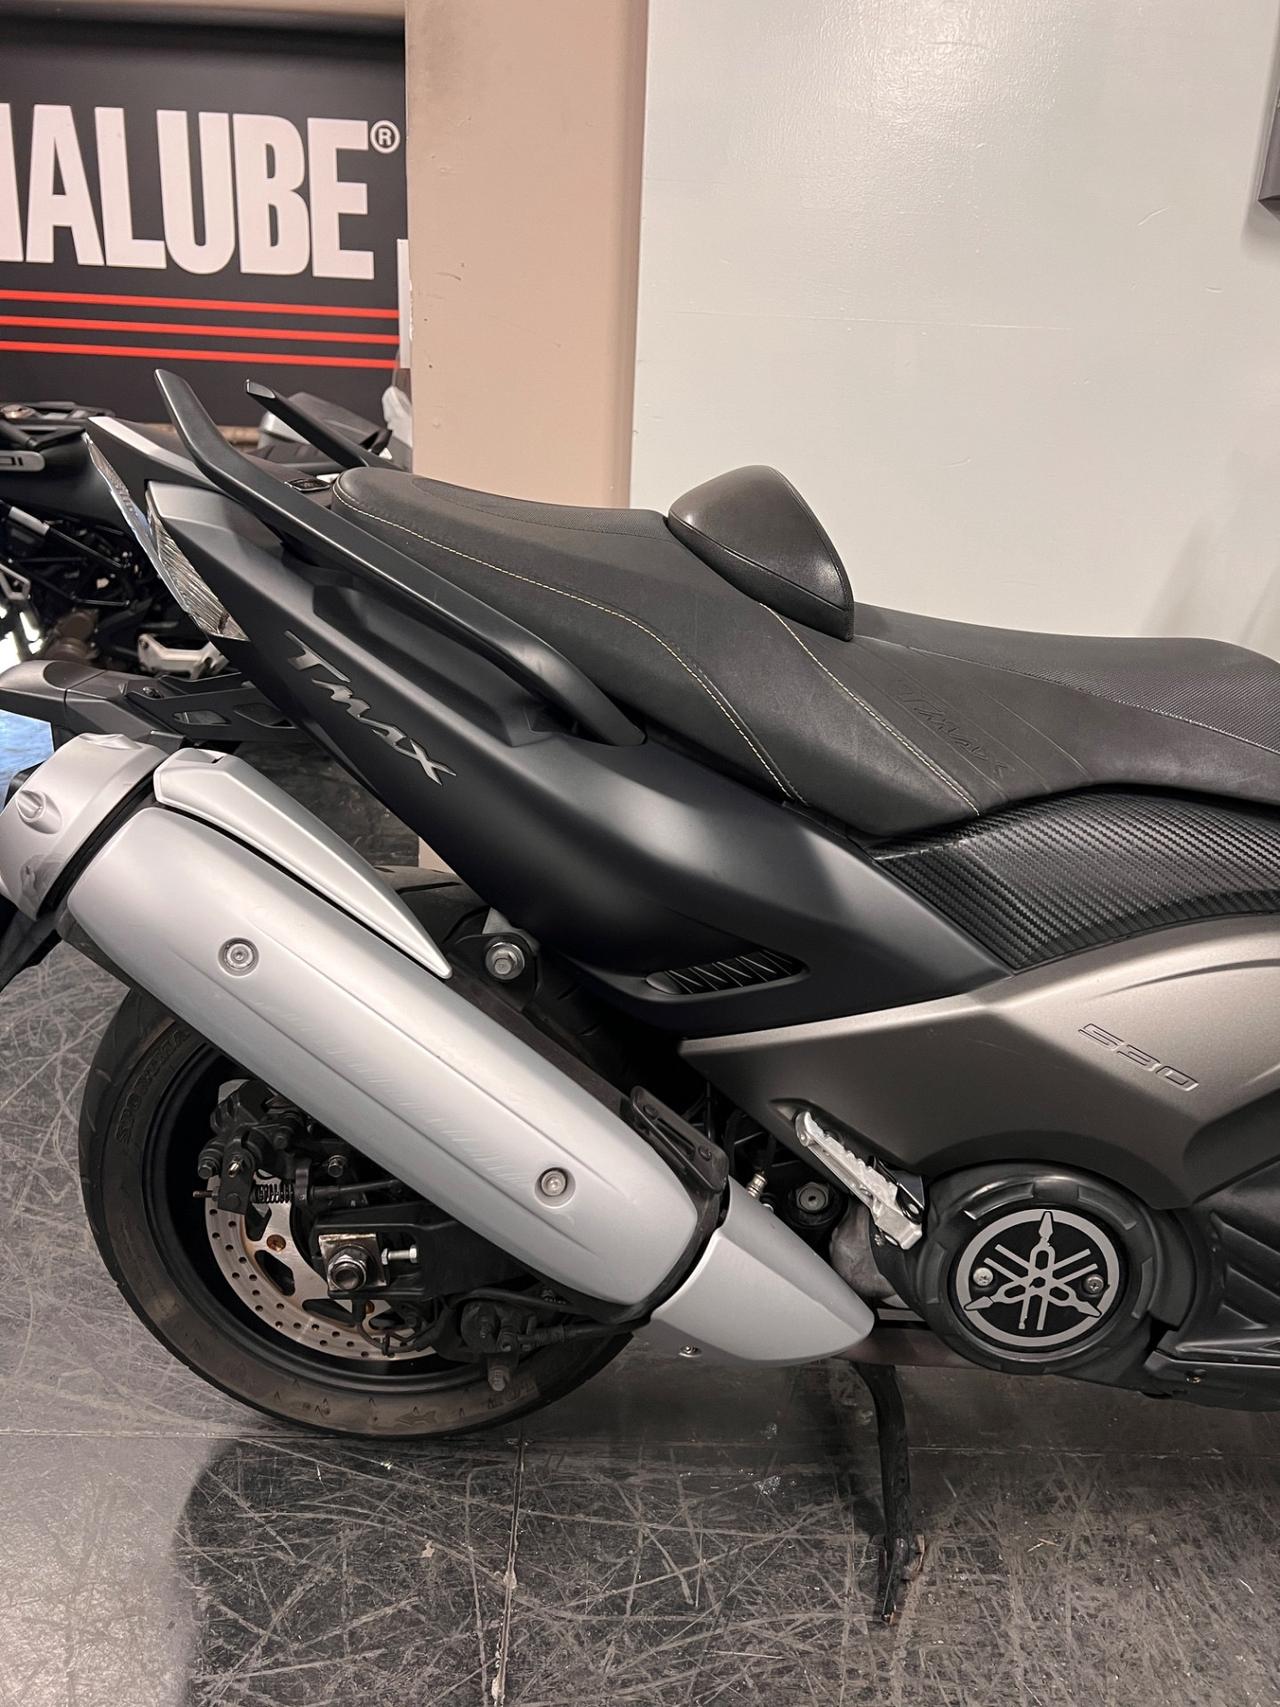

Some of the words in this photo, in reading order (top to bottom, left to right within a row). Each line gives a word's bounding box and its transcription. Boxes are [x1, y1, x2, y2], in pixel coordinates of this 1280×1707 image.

[0, 103, 400, 279] ALUBE®
[284, 630, 457, 786] TMAX
[1078, 1023, 1199, 1091] 530
